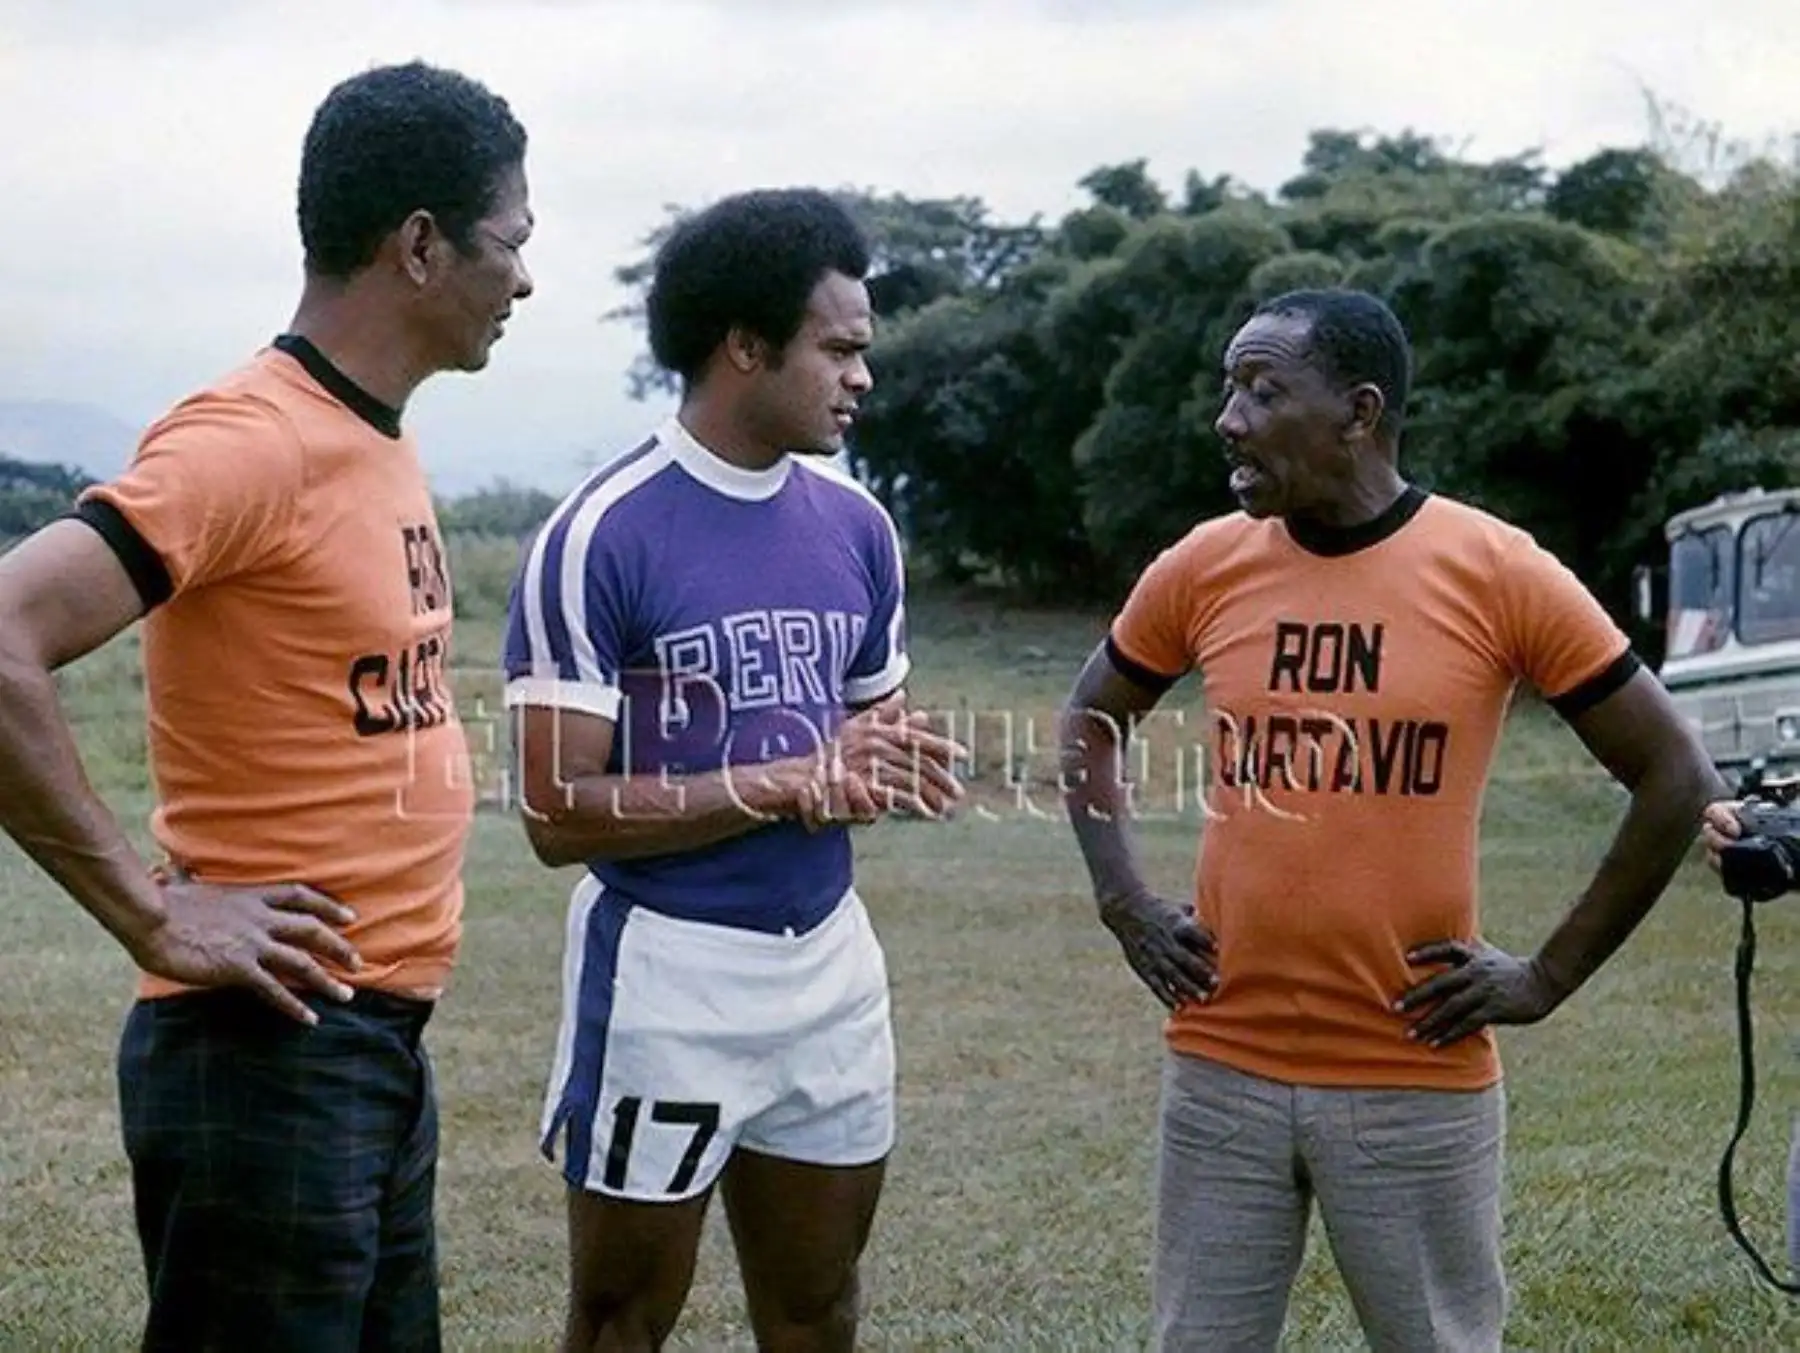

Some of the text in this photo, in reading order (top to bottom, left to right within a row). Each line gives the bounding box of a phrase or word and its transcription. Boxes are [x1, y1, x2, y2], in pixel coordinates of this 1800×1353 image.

[1268, 622, 1384, 693] RON
[1219, 715, 1449, 796] CARTAVIO
[603, 1096, 720, 1193] 17
